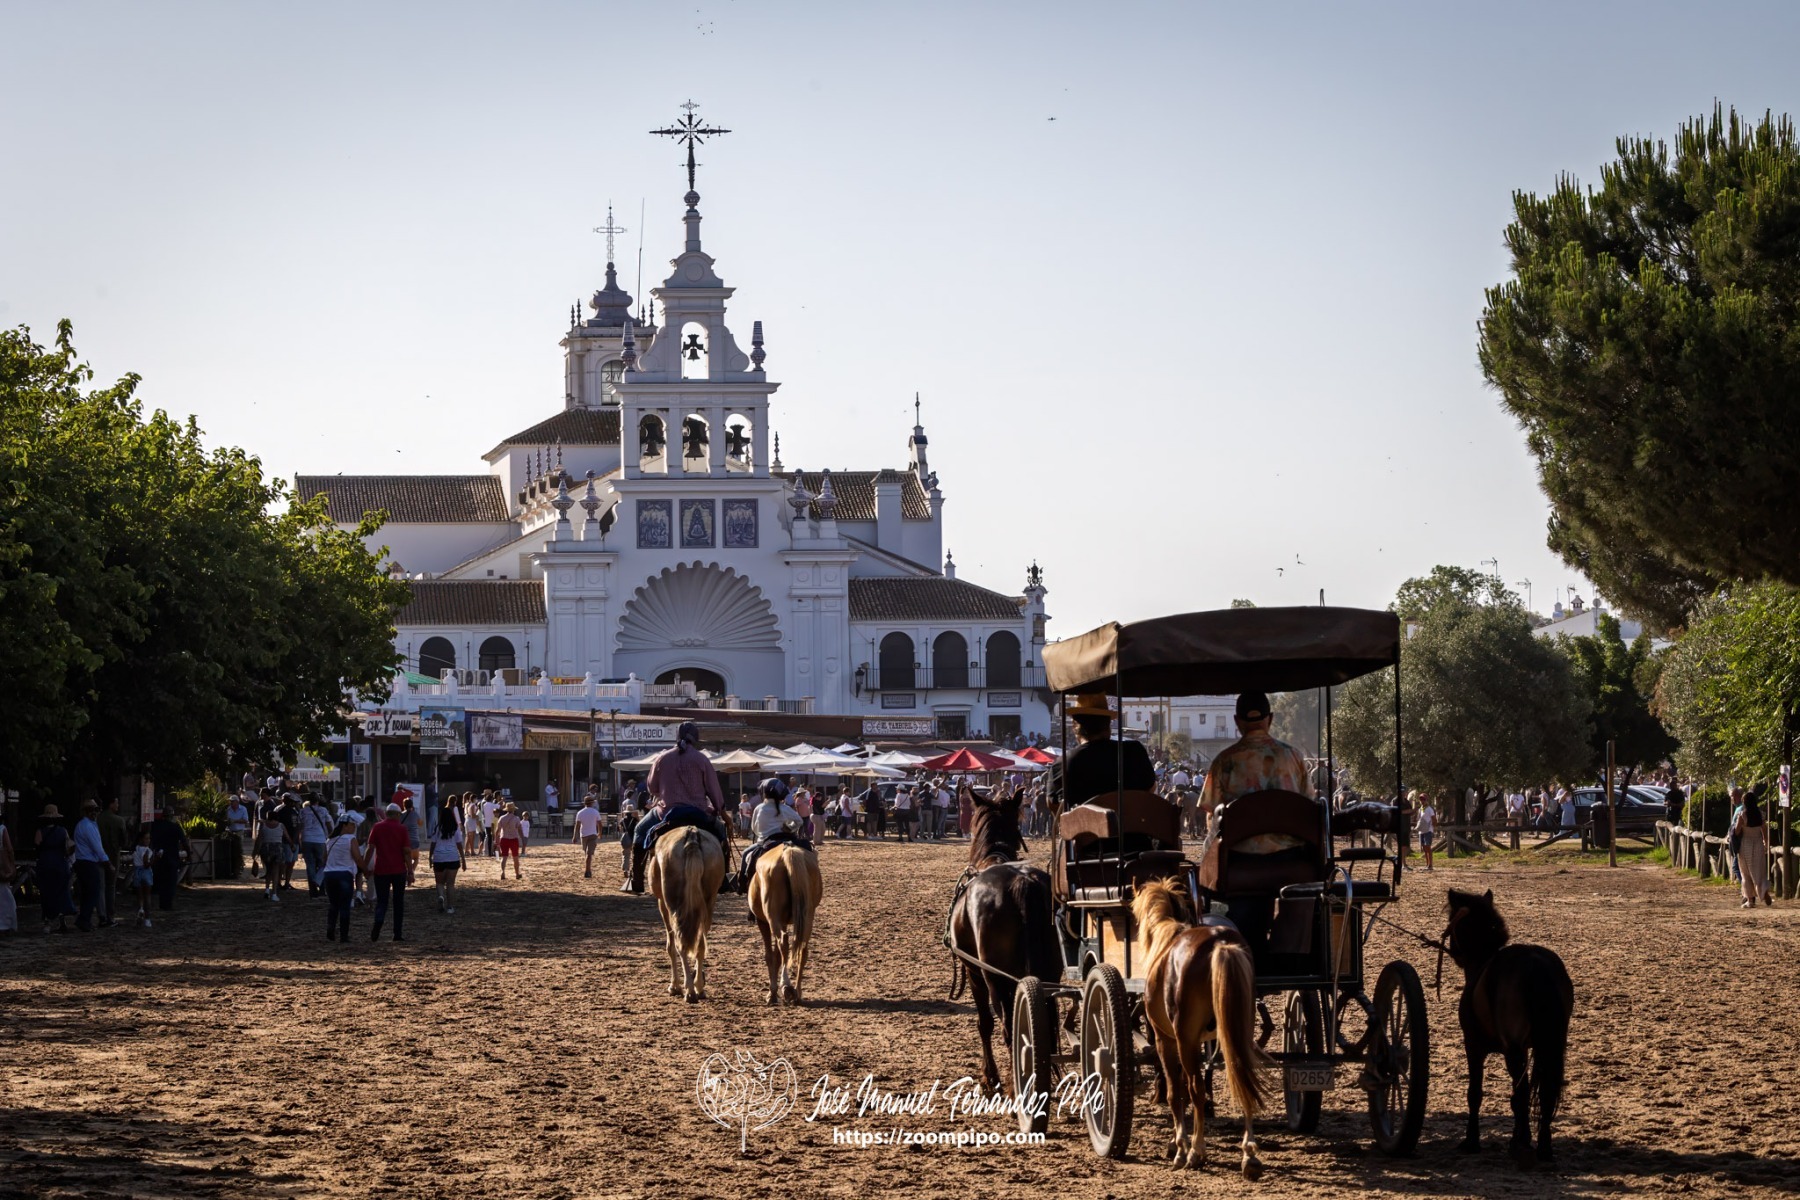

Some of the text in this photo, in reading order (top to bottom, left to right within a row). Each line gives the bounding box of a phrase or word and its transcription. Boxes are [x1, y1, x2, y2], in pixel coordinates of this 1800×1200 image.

[367, 720, 382, 731] CHIC
[383, 711, 393, 734] Y
[421, 720, 443, 729] BODEGA
[421, 729, 455, 737] LOS CAMINOS
[1292, 1071, 1333, 1085] 02657
